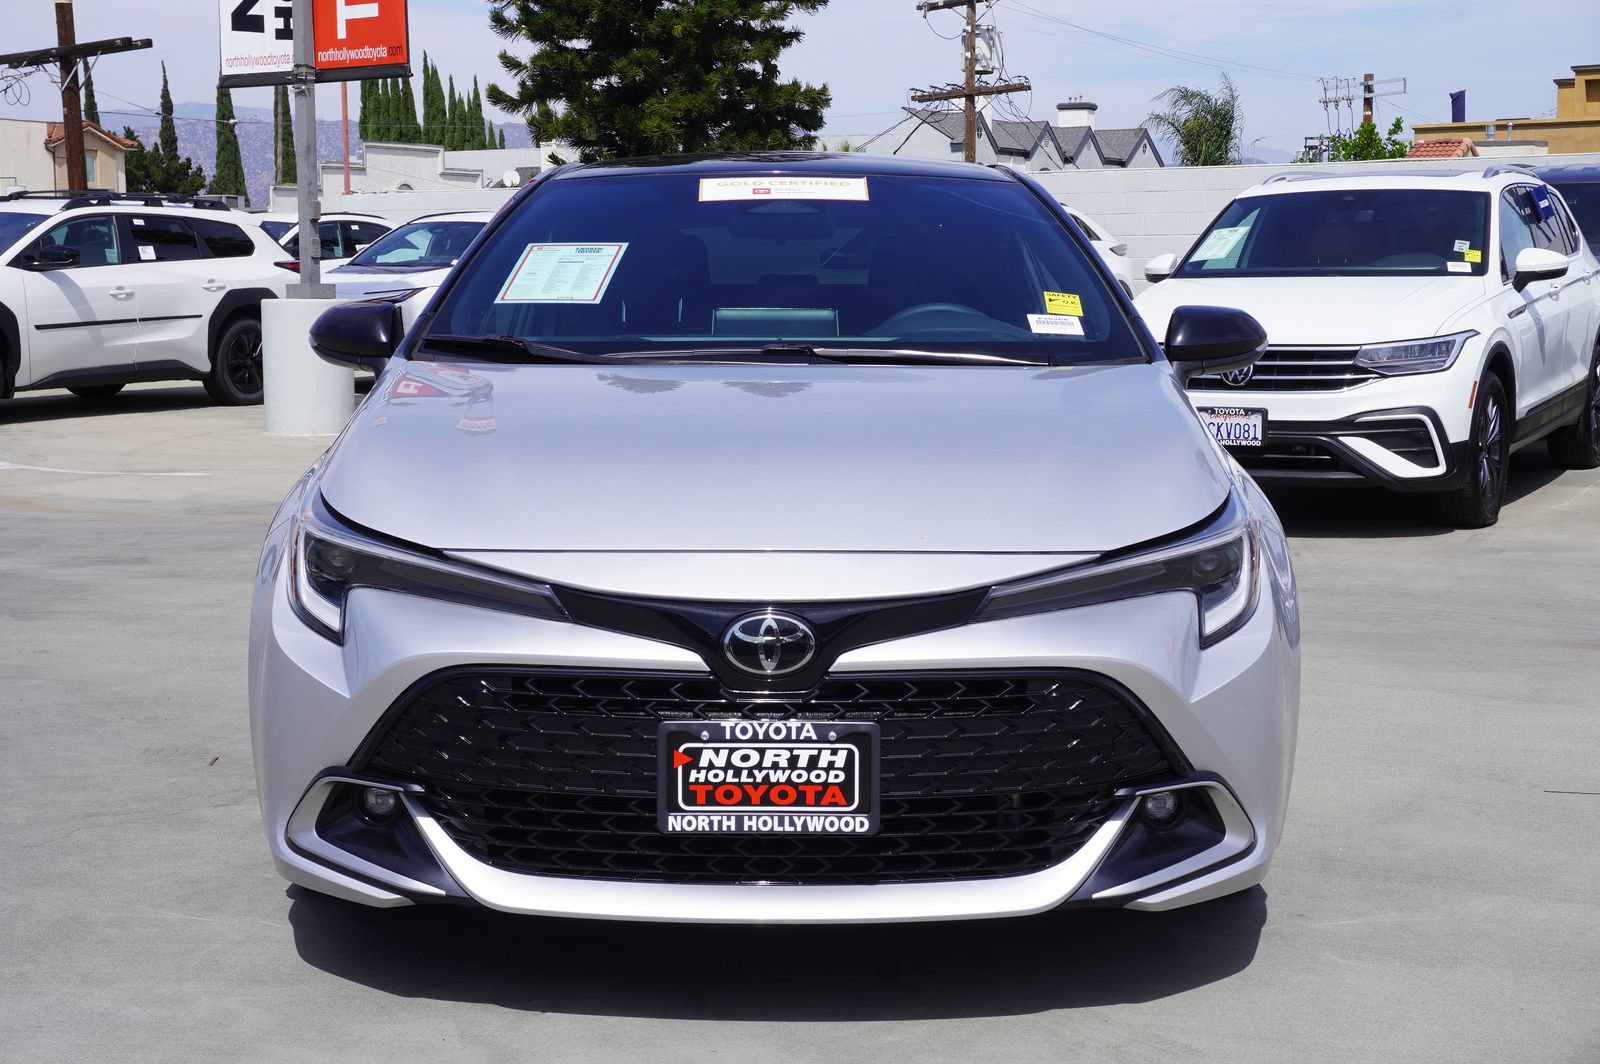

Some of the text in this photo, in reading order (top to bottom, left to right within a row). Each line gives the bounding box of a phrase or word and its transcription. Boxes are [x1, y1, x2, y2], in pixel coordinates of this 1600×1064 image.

[225, 52, 294, 70] northhollywoodtoyota.
[318, 44, 403, 64] northhollywoodtoyota.com
[1214, 407, 1245, 415] TOYOTA
[720, 721, 818, 740] TOYOTA
[698, 748, 848, 768] NORTH
[689, 769, 846, 783] HOLLYWOOD
[688, 784, 848, 806] TOYOTA
[667, 815, 870, 833] NORTH HOLLYWOOD
